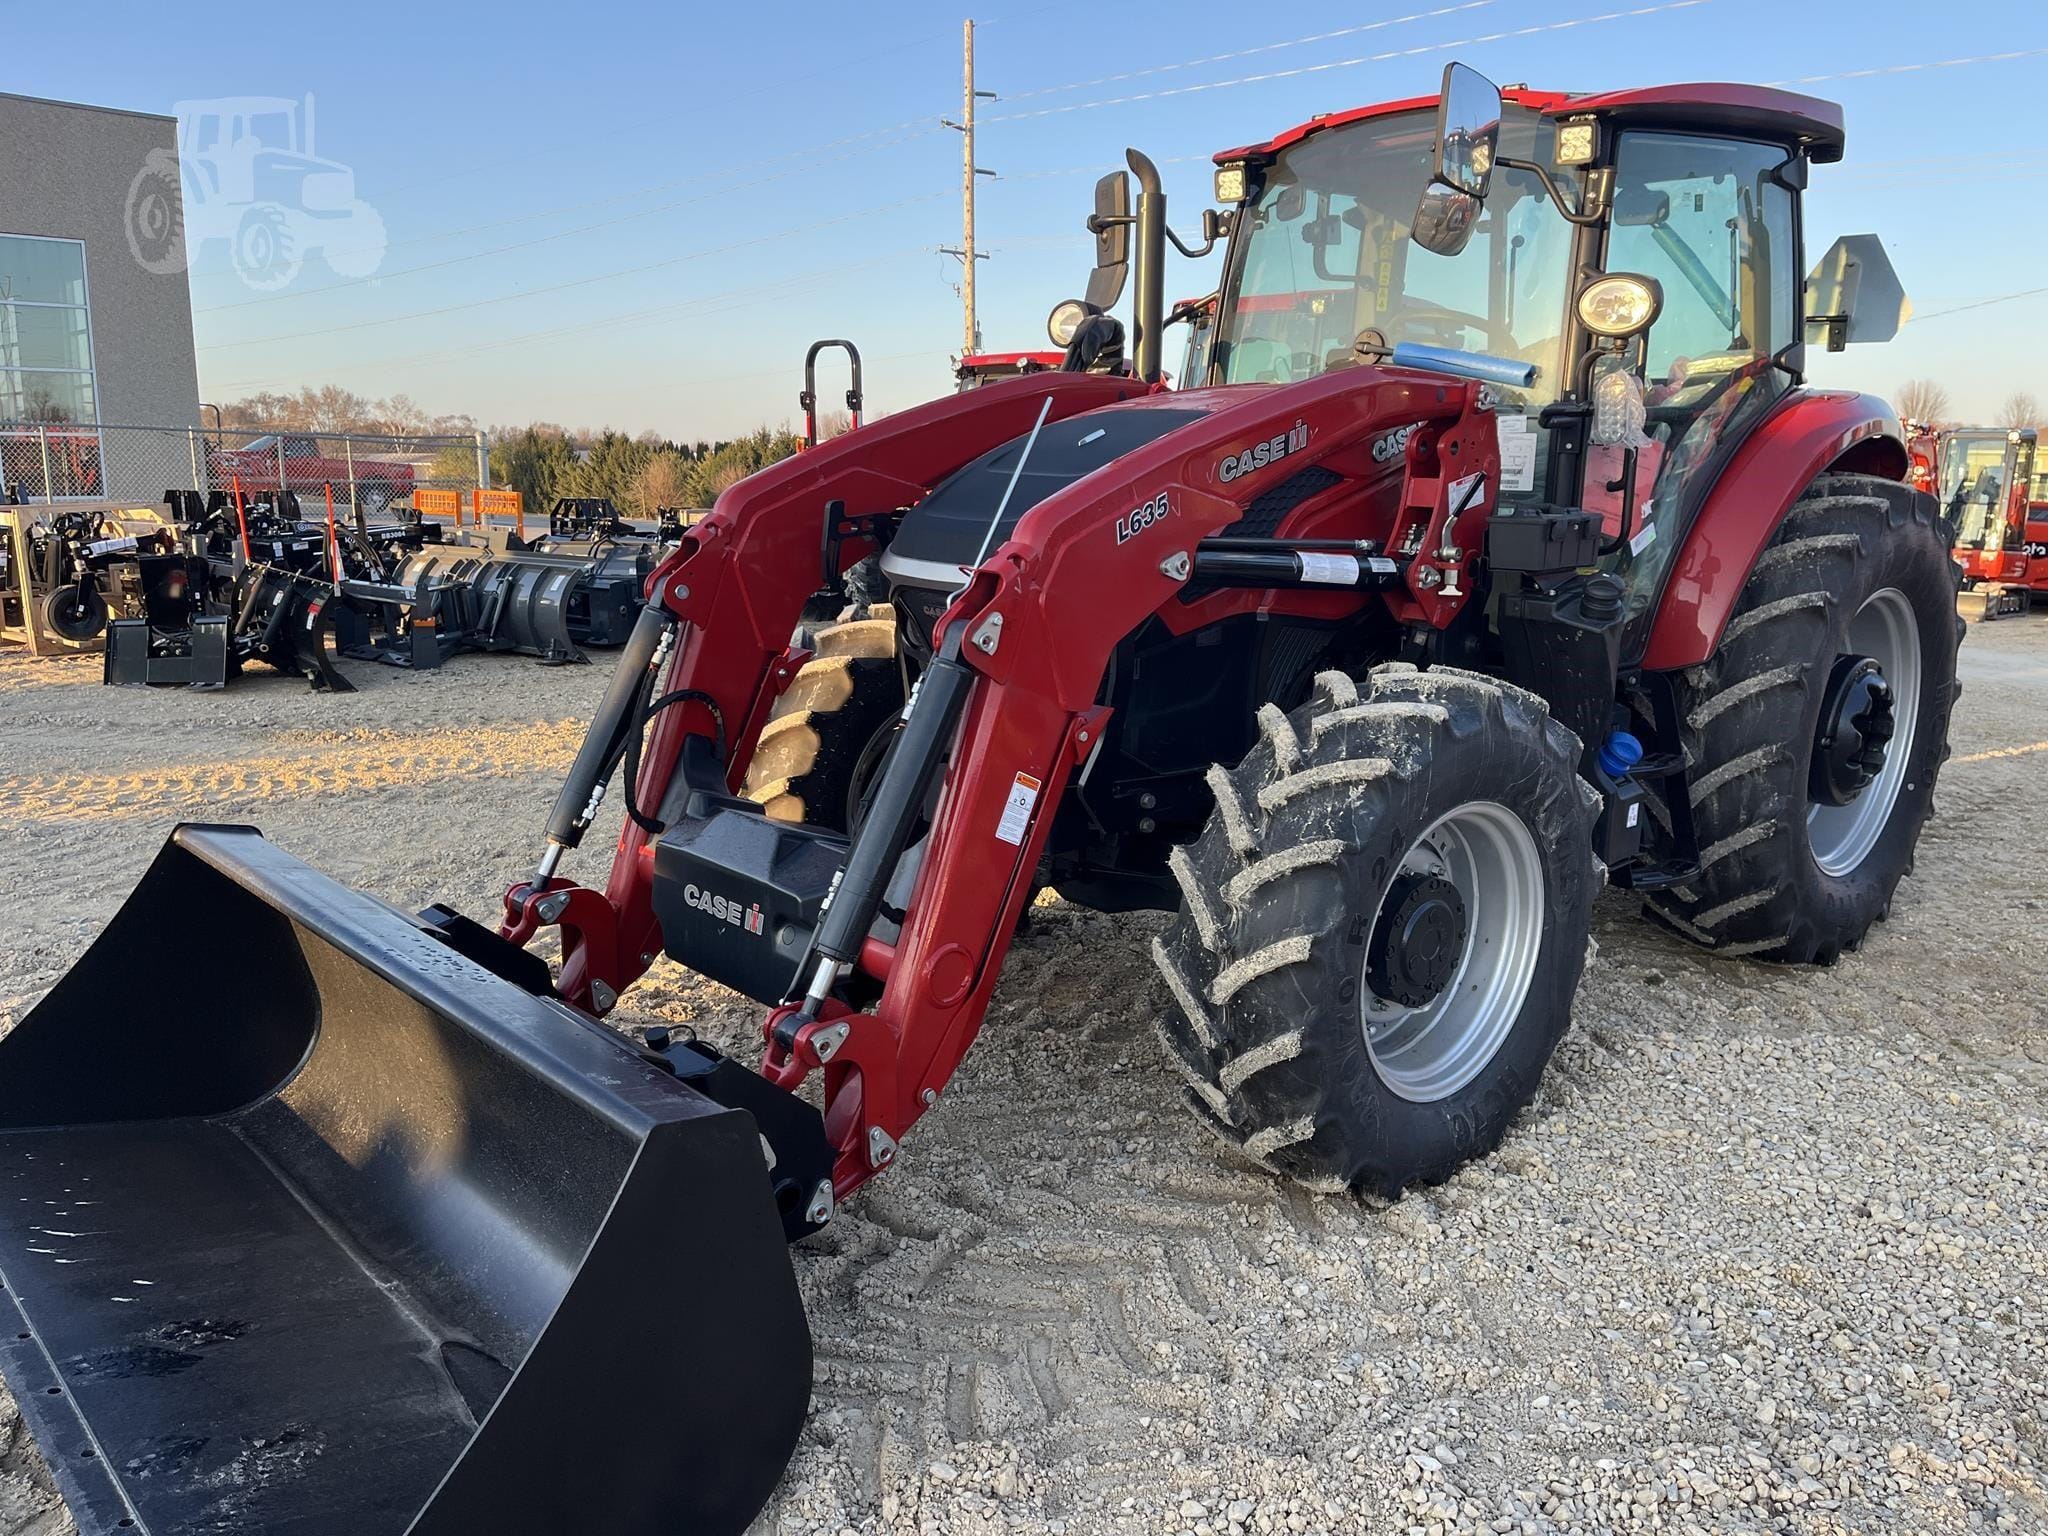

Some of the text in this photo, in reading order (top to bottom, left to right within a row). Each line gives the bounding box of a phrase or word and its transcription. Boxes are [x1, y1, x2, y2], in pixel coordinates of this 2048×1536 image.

[1220, 434, 1285, 483] CASE
[1373, 423, 1417, 462] CAS
[1116, 491, 1169, 545] L635
[684, 884, 743, 927] CASE
